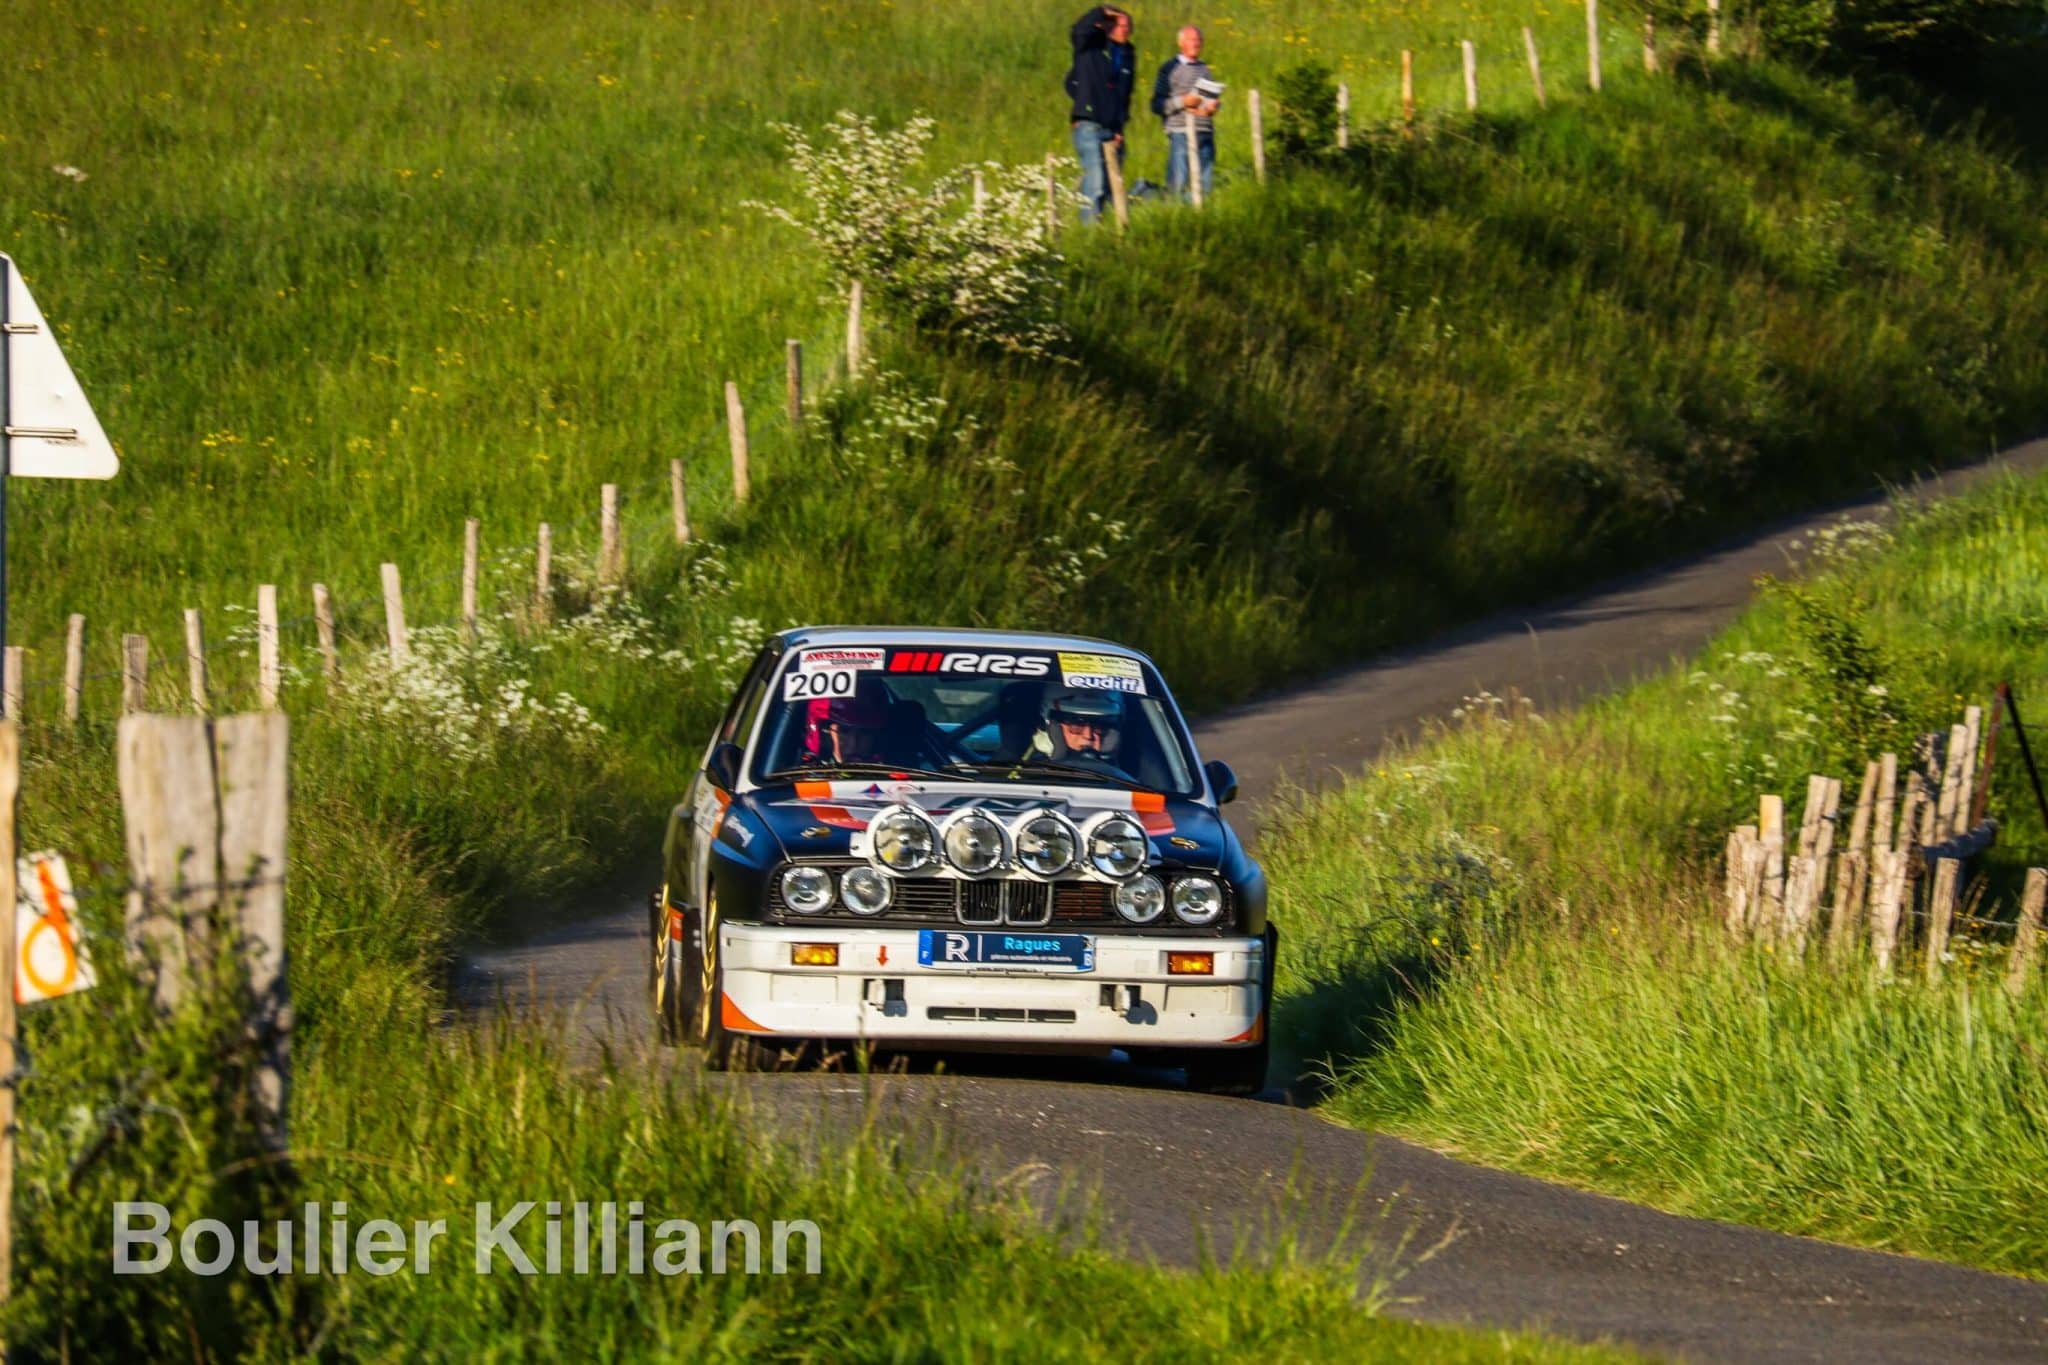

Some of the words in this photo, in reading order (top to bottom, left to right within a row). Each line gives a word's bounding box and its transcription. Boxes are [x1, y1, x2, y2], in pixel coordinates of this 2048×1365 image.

[940, 653, 1051, 675] RRS
[790, 671, 851, 697] 200
[1004, 937, 1061, 952] Ragues
